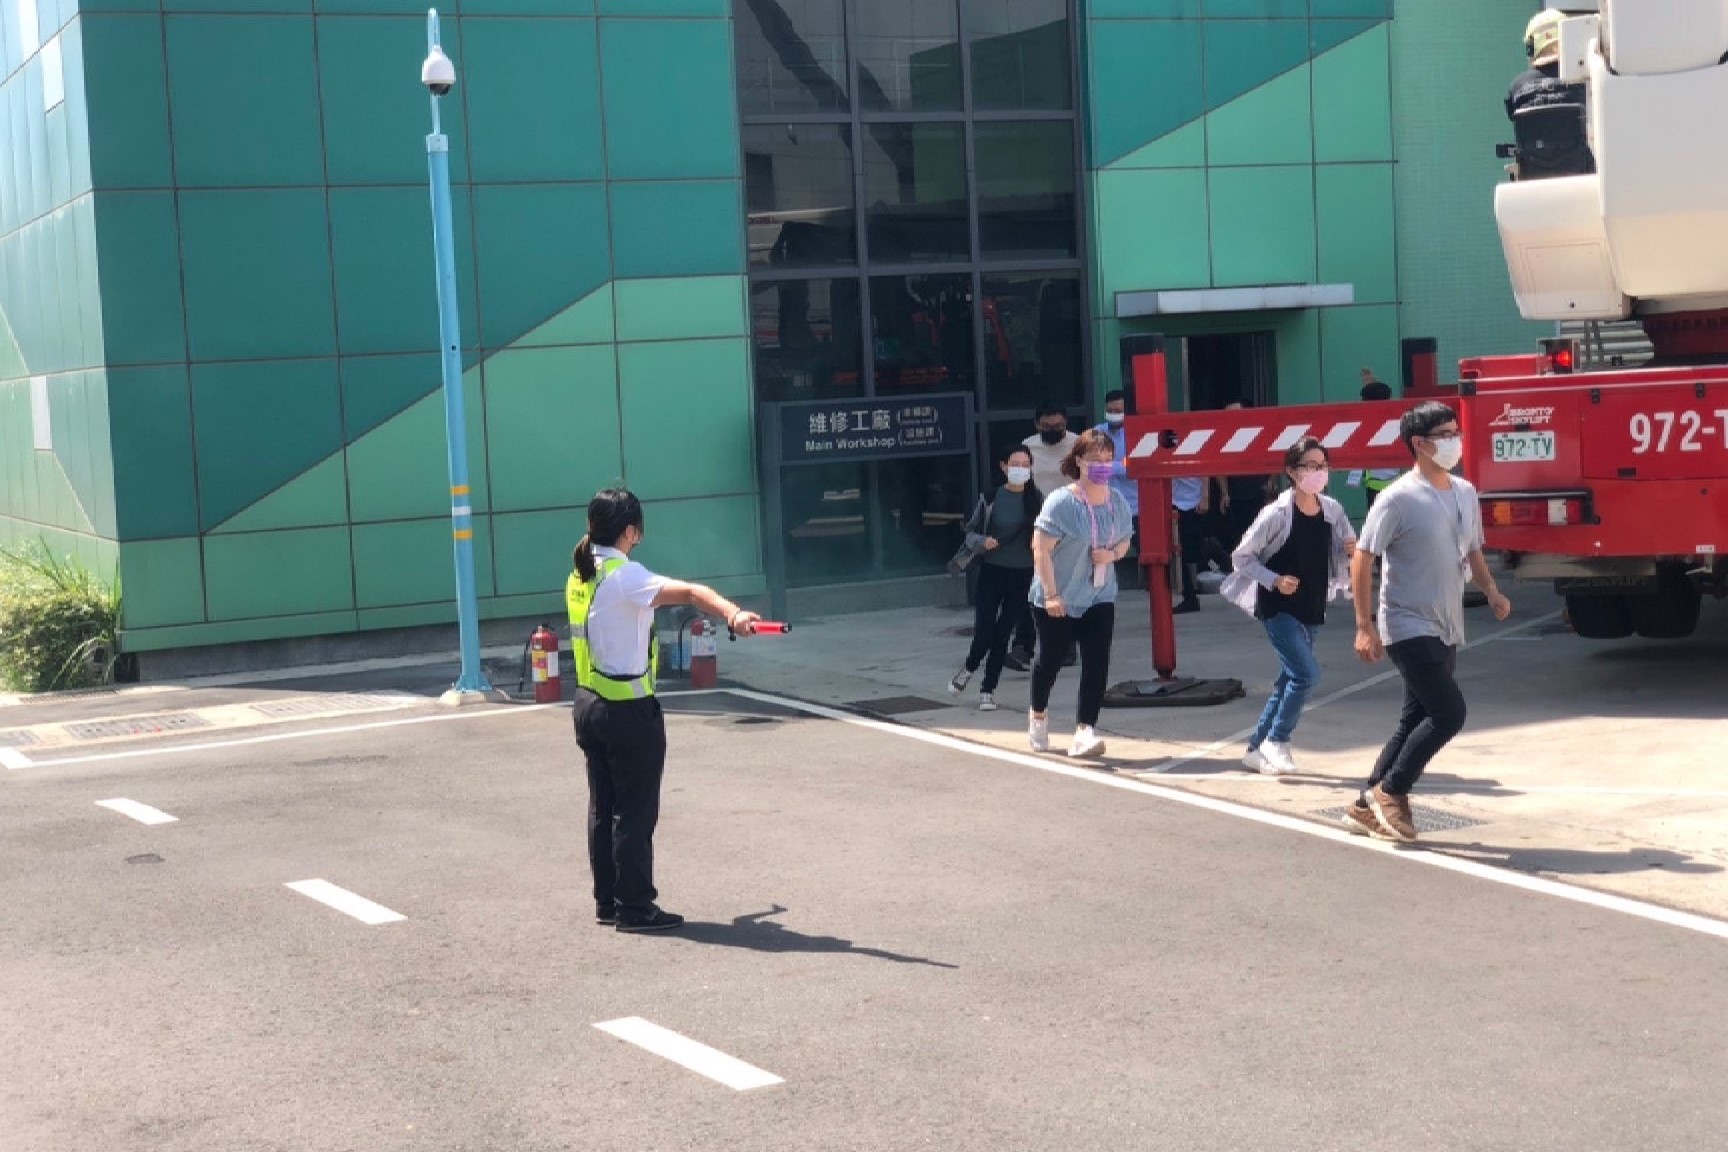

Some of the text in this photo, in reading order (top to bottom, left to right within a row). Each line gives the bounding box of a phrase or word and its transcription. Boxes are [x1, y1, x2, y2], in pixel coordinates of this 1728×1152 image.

[809, 409, 891, 434] 維修工廠
[805, 440, 833, 452] Main
[836, 436, 895, 449] Workshop
